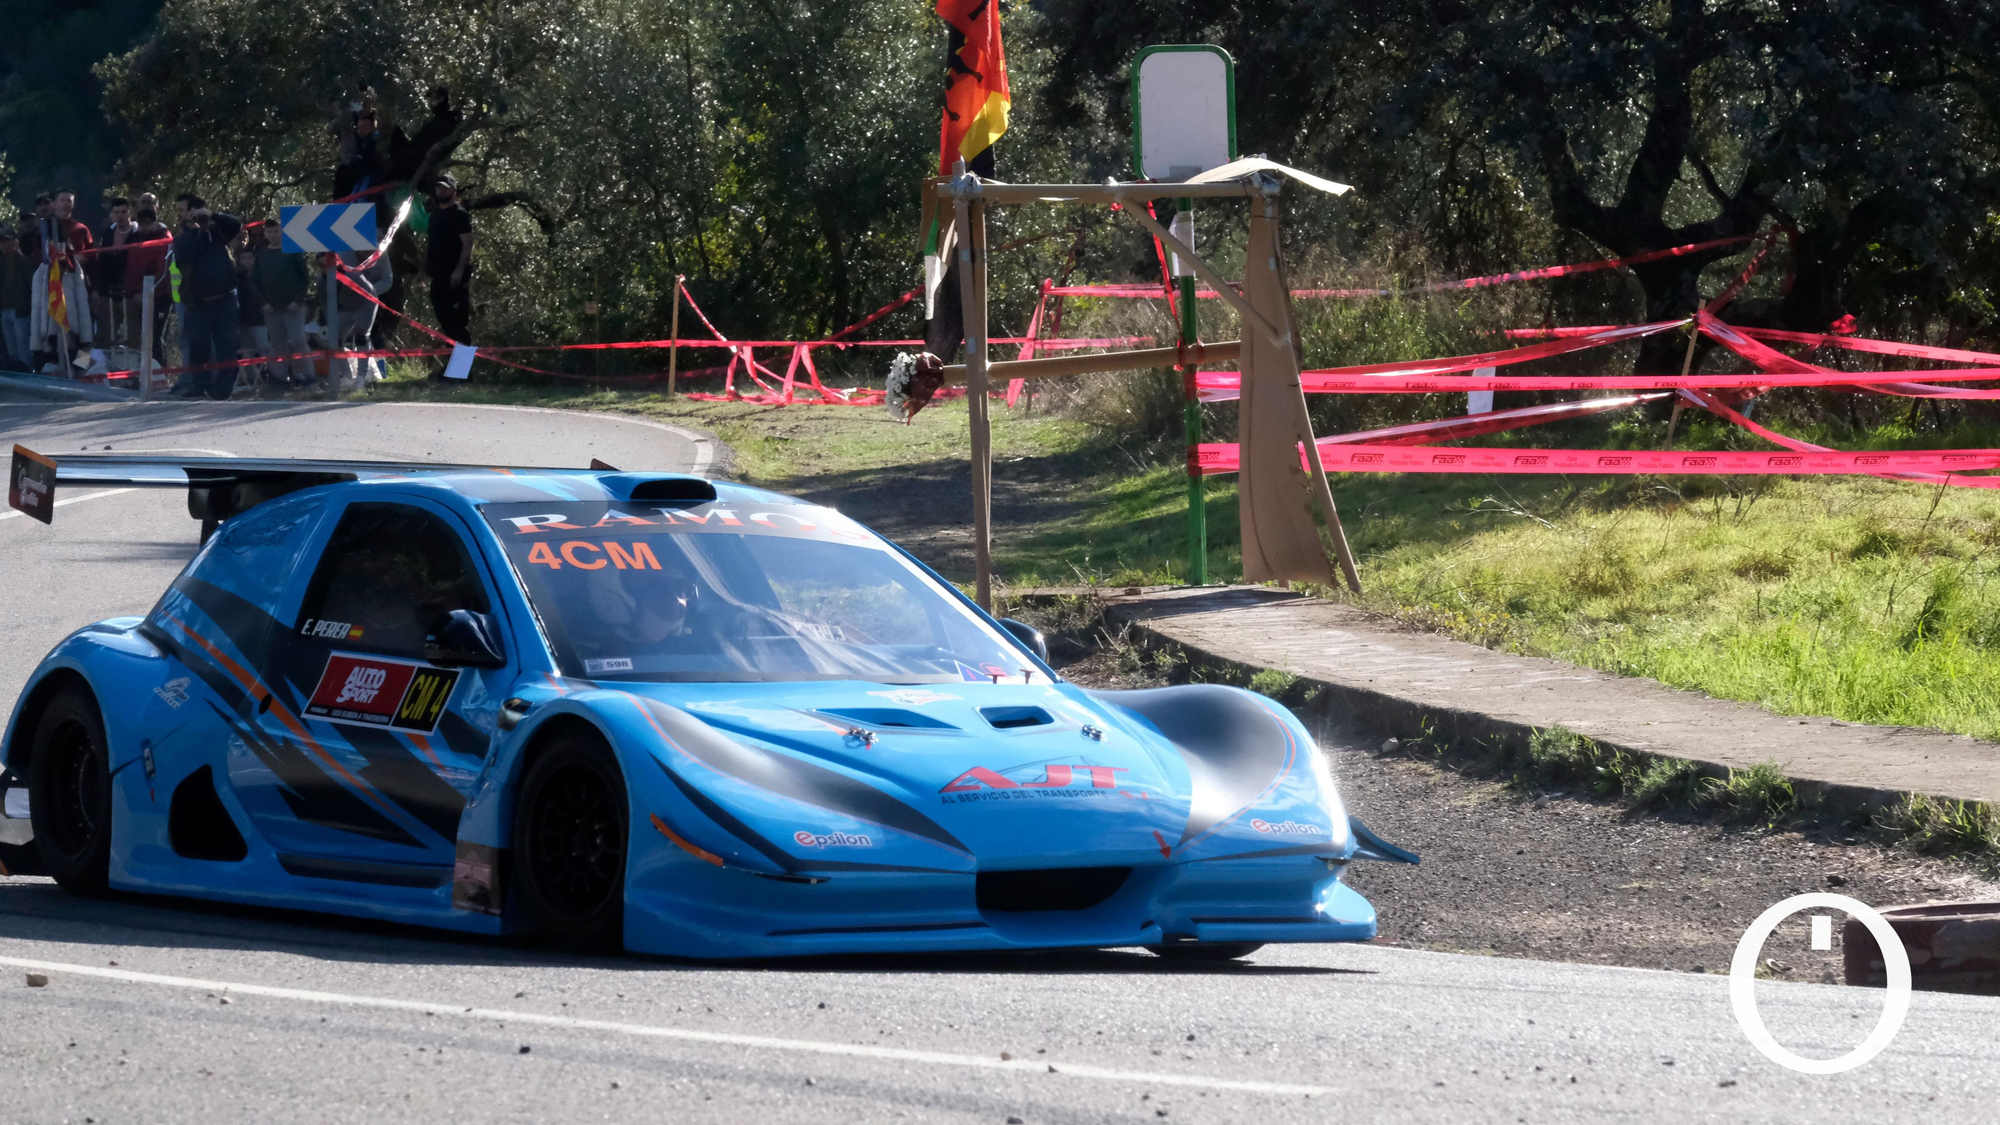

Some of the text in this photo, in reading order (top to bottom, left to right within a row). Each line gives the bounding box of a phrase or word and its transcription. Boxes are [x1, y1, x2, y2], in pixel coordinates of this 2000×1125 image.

[528, 541, 662, 570] 4CM
[312, 619, 351, 639] PEREA
[606, 660, 629, 668] 598
[345, 666, 386, 689] AUTO
[401, 674, 452, 722] CM 4
[938, 764, 1129, 793] AJT
[941, 796, 956, 804] AL
[957, 791, 1010, 803] SERVICIO
[1012, 790, 1034, 799] DEL
[1035, 789, 1110, 799] TRANSPORTE
[1252, 819, 1319, 835] epsilon
[795, 832, 870, 848] epsilon
